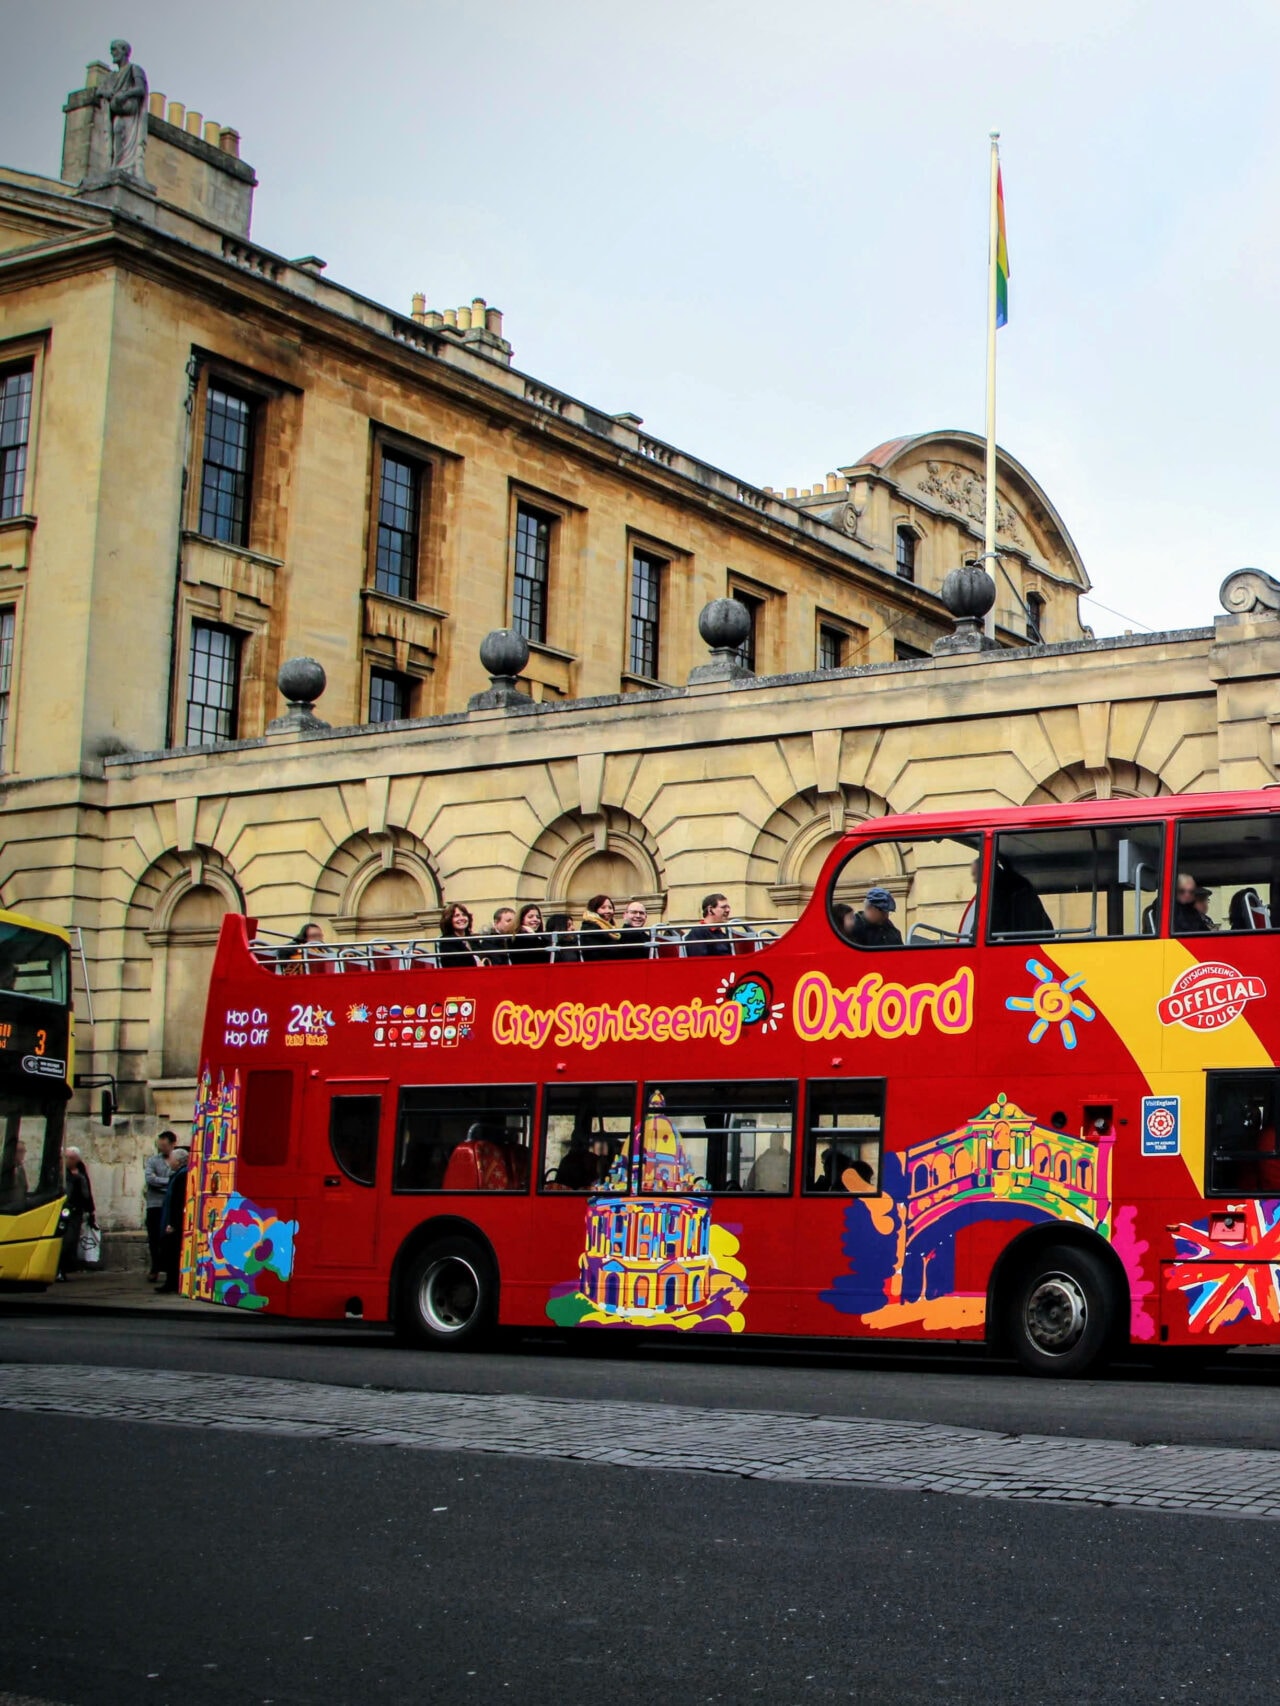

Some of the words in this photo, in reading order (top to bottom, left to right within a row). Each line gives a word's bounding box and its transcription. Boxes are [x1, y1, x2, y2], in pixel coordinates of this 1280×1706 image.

[1180, 966, 1235, 989] CITYSIGHTSEEING
[793, 966, 975, 1042] Oxford
[1168, 980, 1260, 1018] OFFICIAL
[226, 1010, 249, 1026] Hop
[252, 1008, 268, 1024] On
[1198, 1006, 1238, 1026] TOUR
[34, 1029, 47, 1055] 3
[225, 1030, 248, 1046] Hop
[250, 1029, 269, 1044] Off
